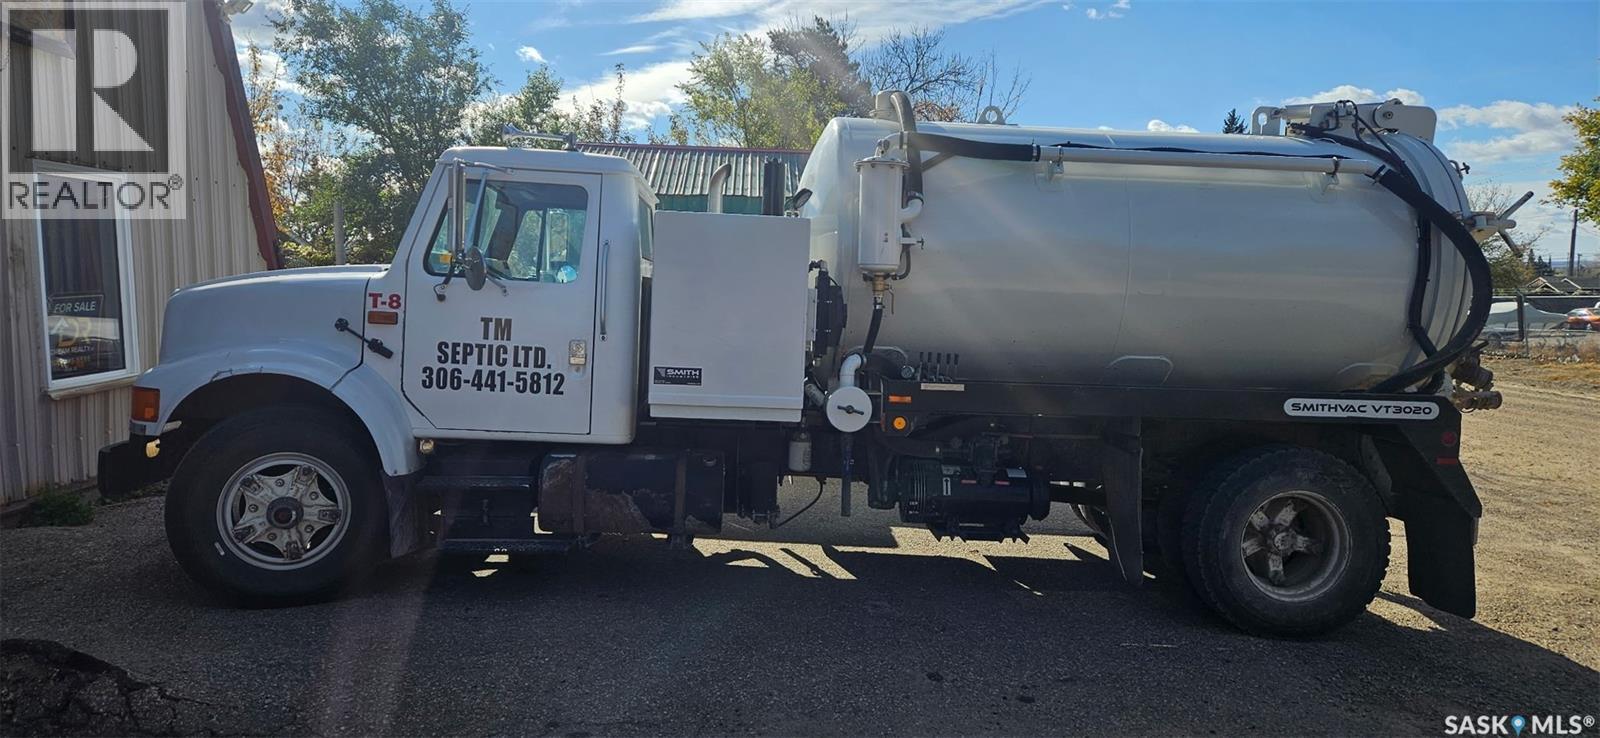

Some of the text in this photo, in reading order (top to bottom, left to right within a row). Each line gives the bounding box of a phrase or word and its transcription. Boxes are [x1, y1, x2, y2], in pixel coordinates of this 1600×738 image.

[54, 301, 95, 313] FOR SALE
[368, 293, 401, 310] T-8
[480, 317, 513, 341] TM
[437, 341, 552, 369] SEPTIC LTD.
[421, 366, 566, 395] 306-441-5812
[1291, 402, 1433, 415] SMITHVAC VT3020
